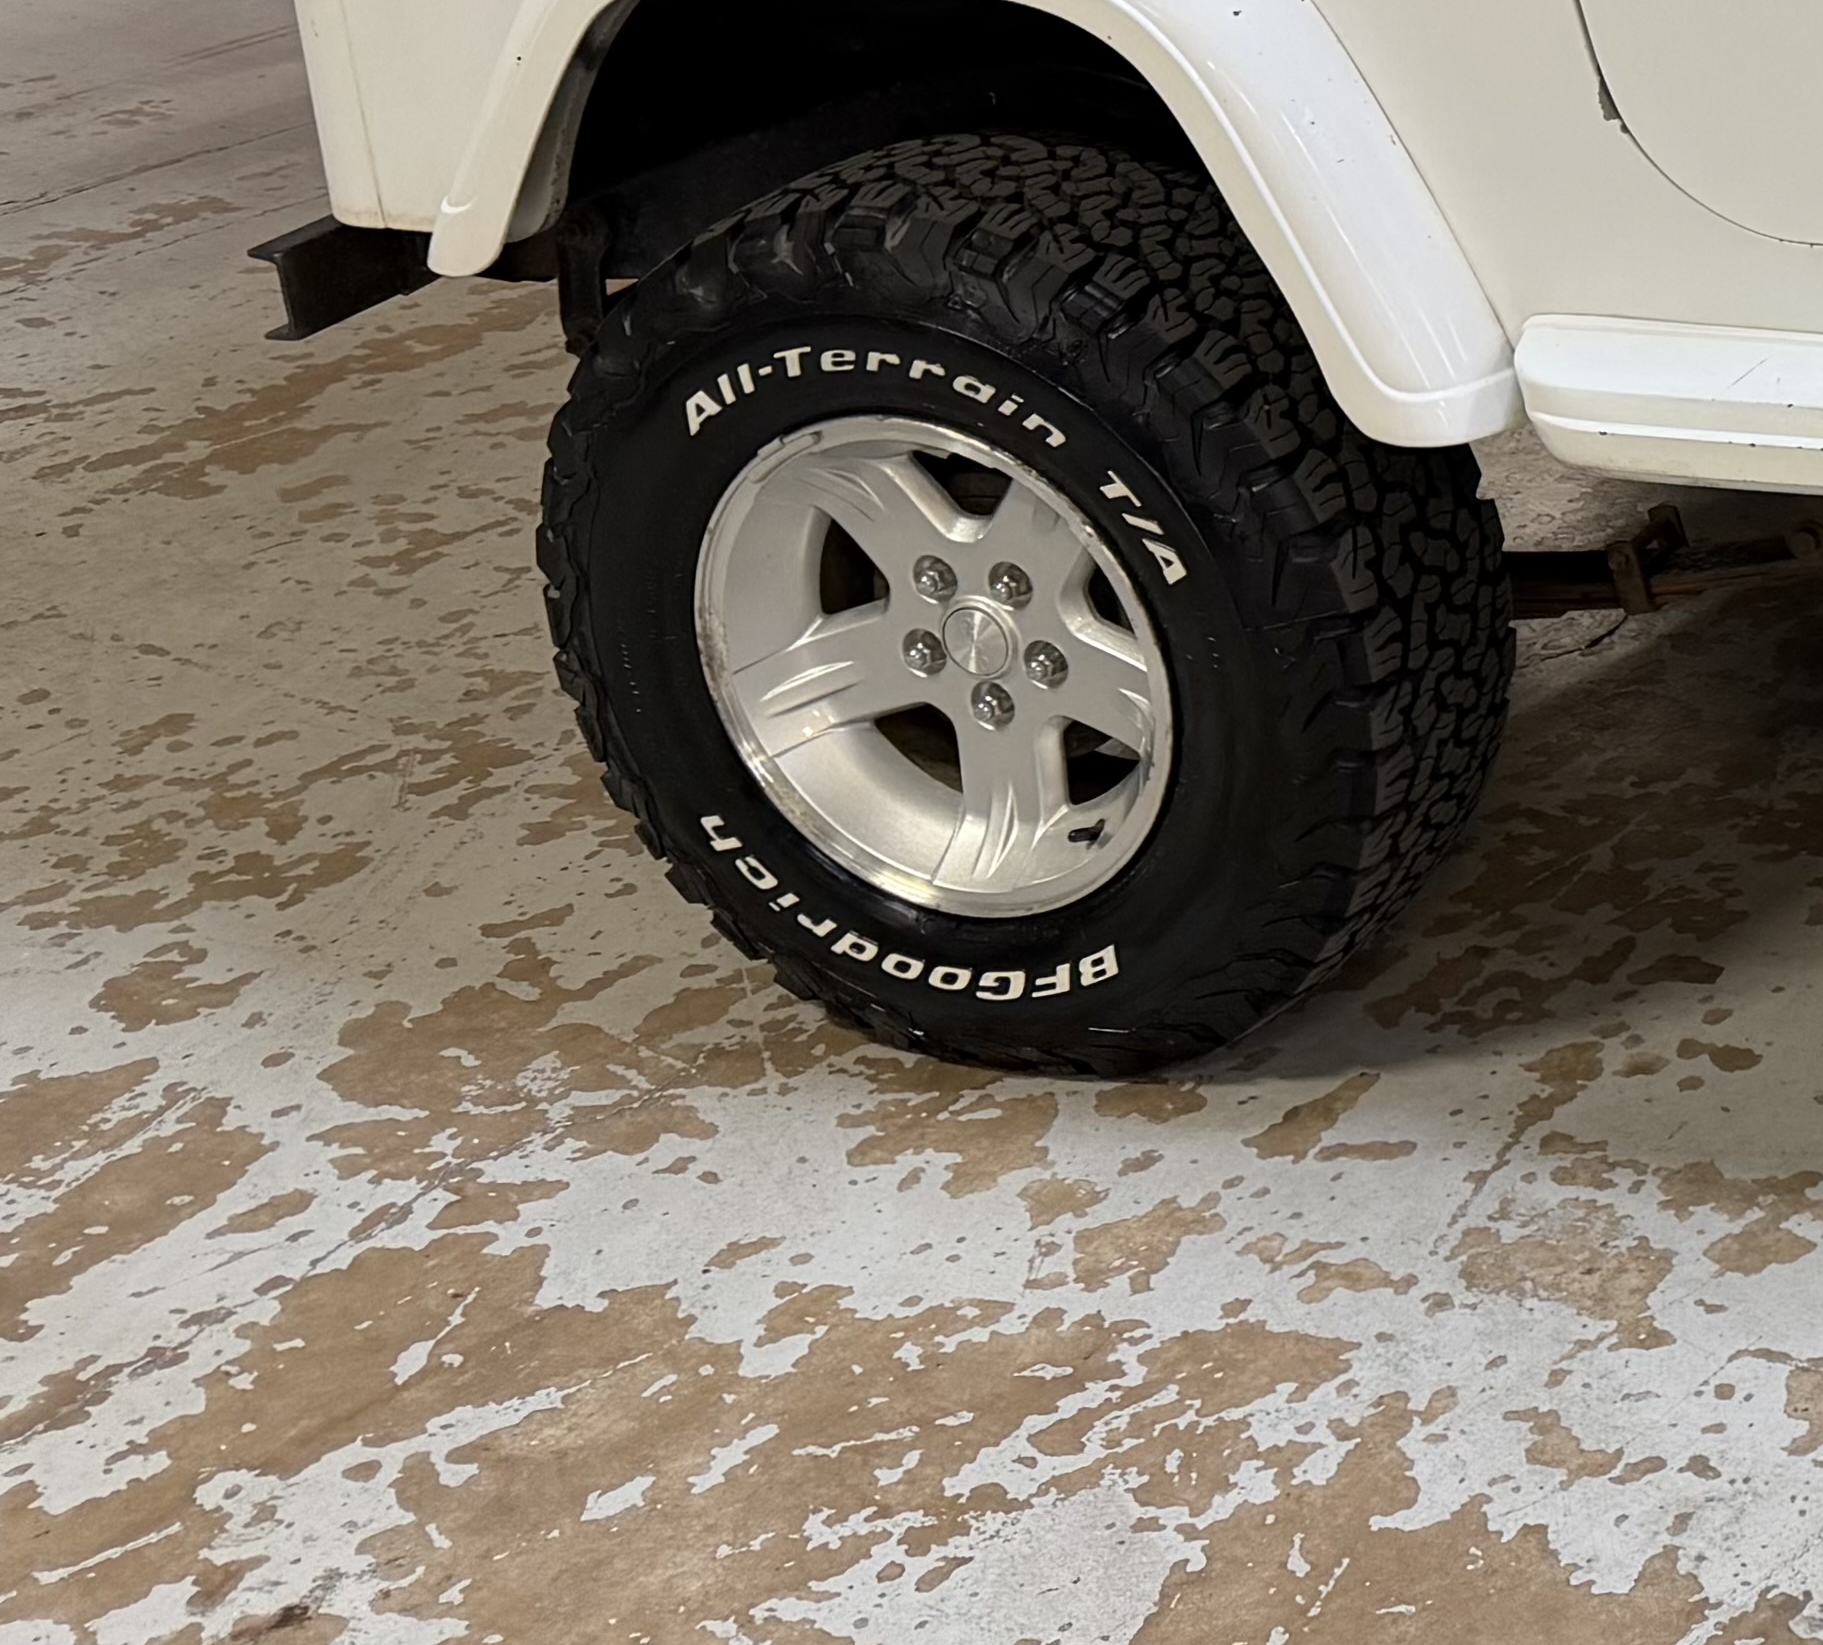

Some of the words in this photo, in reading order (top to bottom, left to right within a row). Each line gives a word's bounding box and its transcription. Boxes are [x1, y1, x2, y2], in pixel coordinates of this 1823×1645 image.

[685, 346, 1067, 448] All-Terrain
[1100, 470, 1187, 585] T/A
[700, 815, 1120, 1001] BFGoodrich
